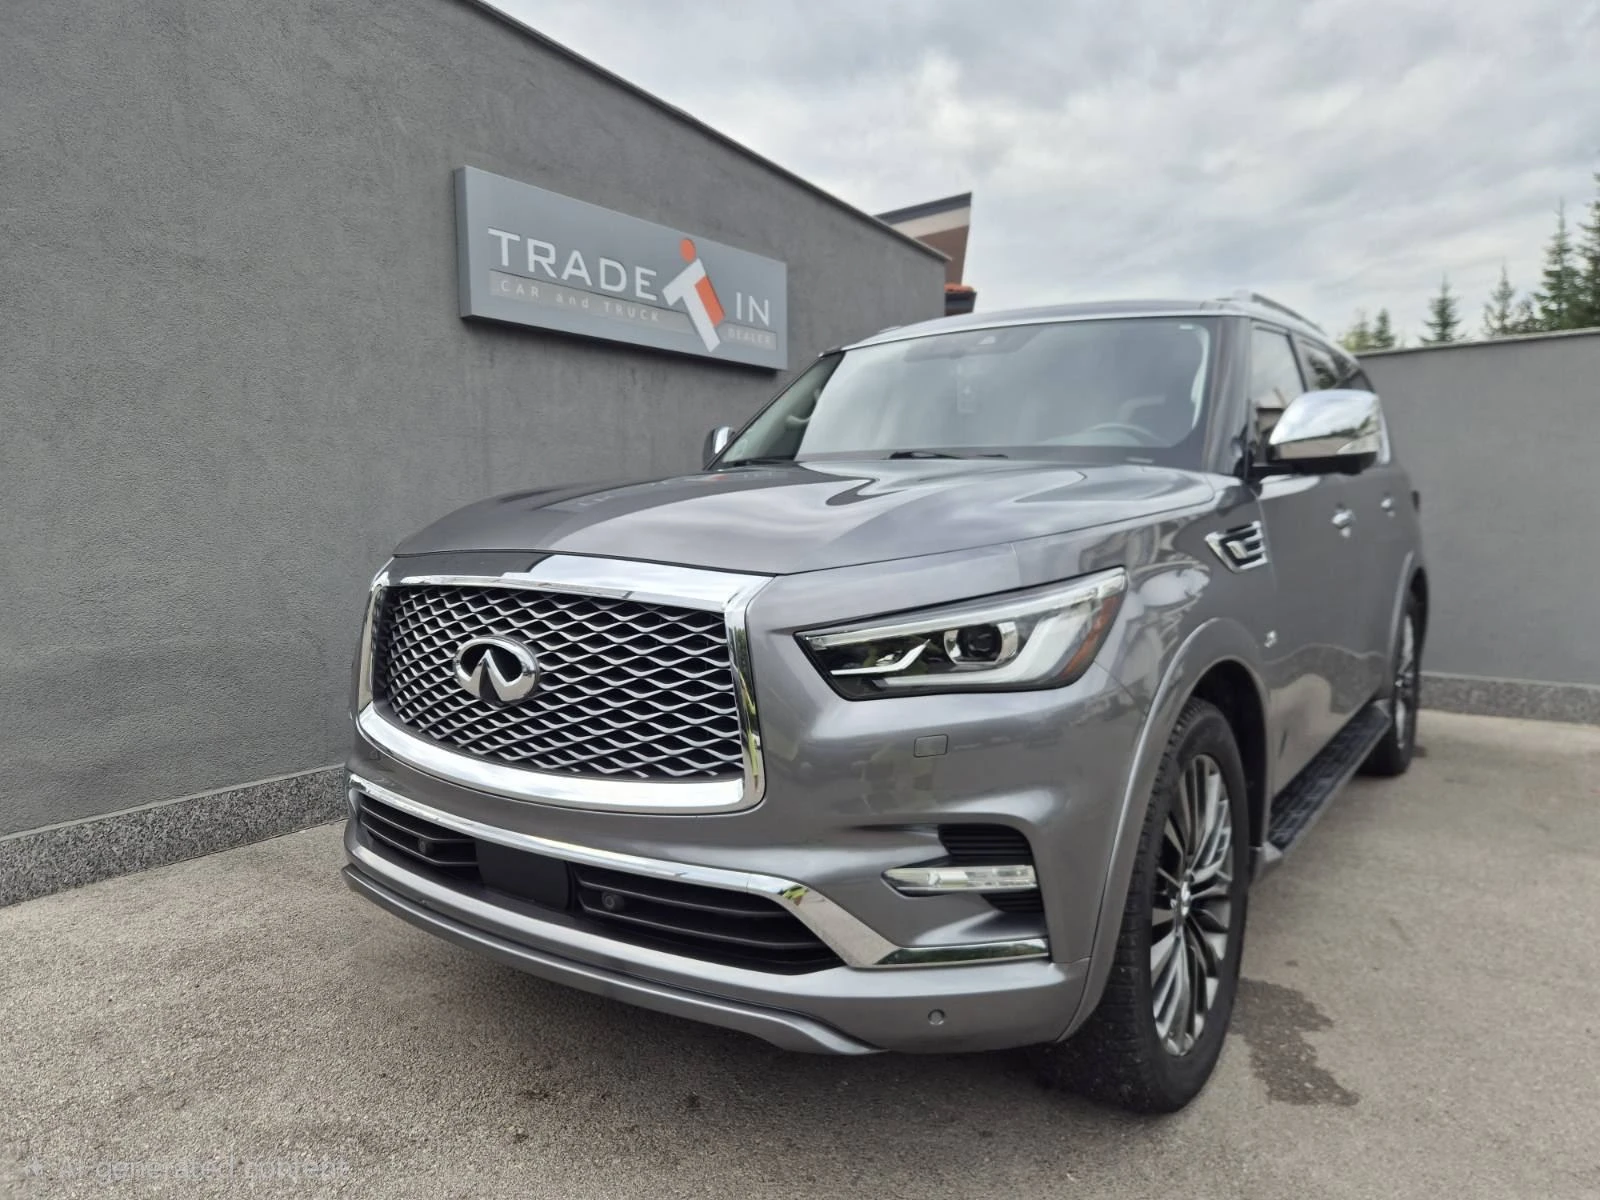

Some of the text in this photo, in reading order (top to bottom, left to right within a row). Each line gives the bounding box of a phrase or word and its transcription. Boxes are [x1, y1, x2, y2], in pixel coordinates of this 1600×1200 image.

[488, 226, 658, 301] TRADE
[736, 291, 769, 327] IN
[500, 280, 540, 298] CAR
[555, 293, 590, 309] and
[604, 301, 660, 322] TRUCK
